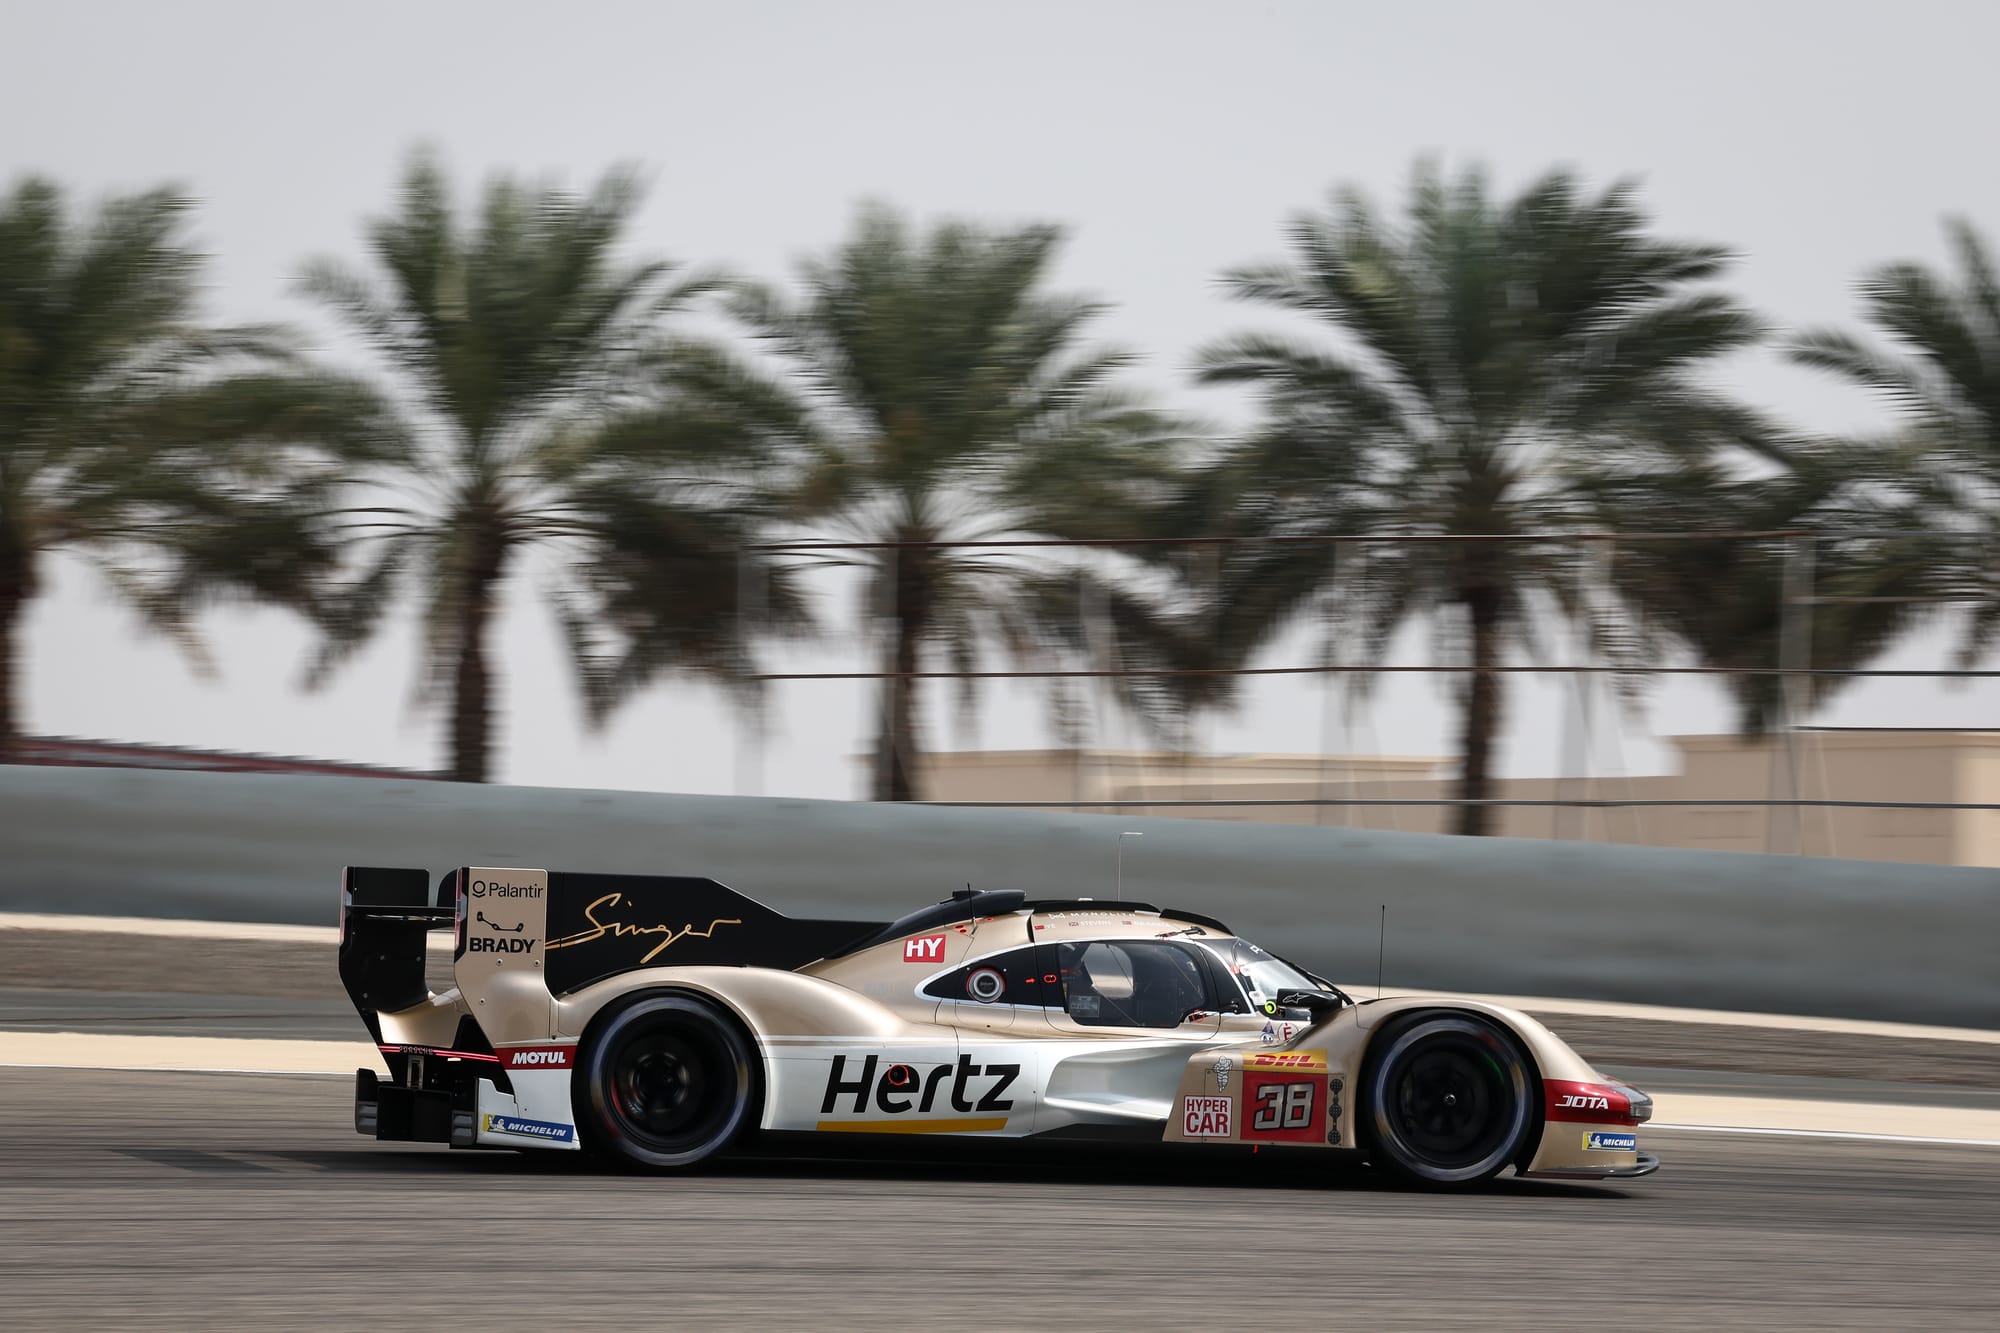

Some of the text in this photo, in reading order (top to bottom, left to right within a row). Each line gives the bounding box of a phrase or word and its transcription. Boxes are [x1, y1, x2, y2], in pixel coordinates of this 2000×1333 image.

[489, 882, 543, 898] Palantir
[545, 893, 742, 964] Singer
[469, 937, 536, 954] BRADY
[906, 937, 943, 957] HY
[512, 1051, 567, 1065] MOTUL
[1255, 1054, 1315, 1068] DHL
[820, 1054, 1021, 1113] Hertz
[1187, 1099, 1228, 1112] HYPER
[1253, 1082, 1316, 1131] 38
[1555, 1095, 1609, 1109] JOTA
[507, 1122, 567, 1137] MICHELIN
[1186, 1112, 1229, 1134] CAR
[1603, 1138, 1635, 1147] MICHELIN
